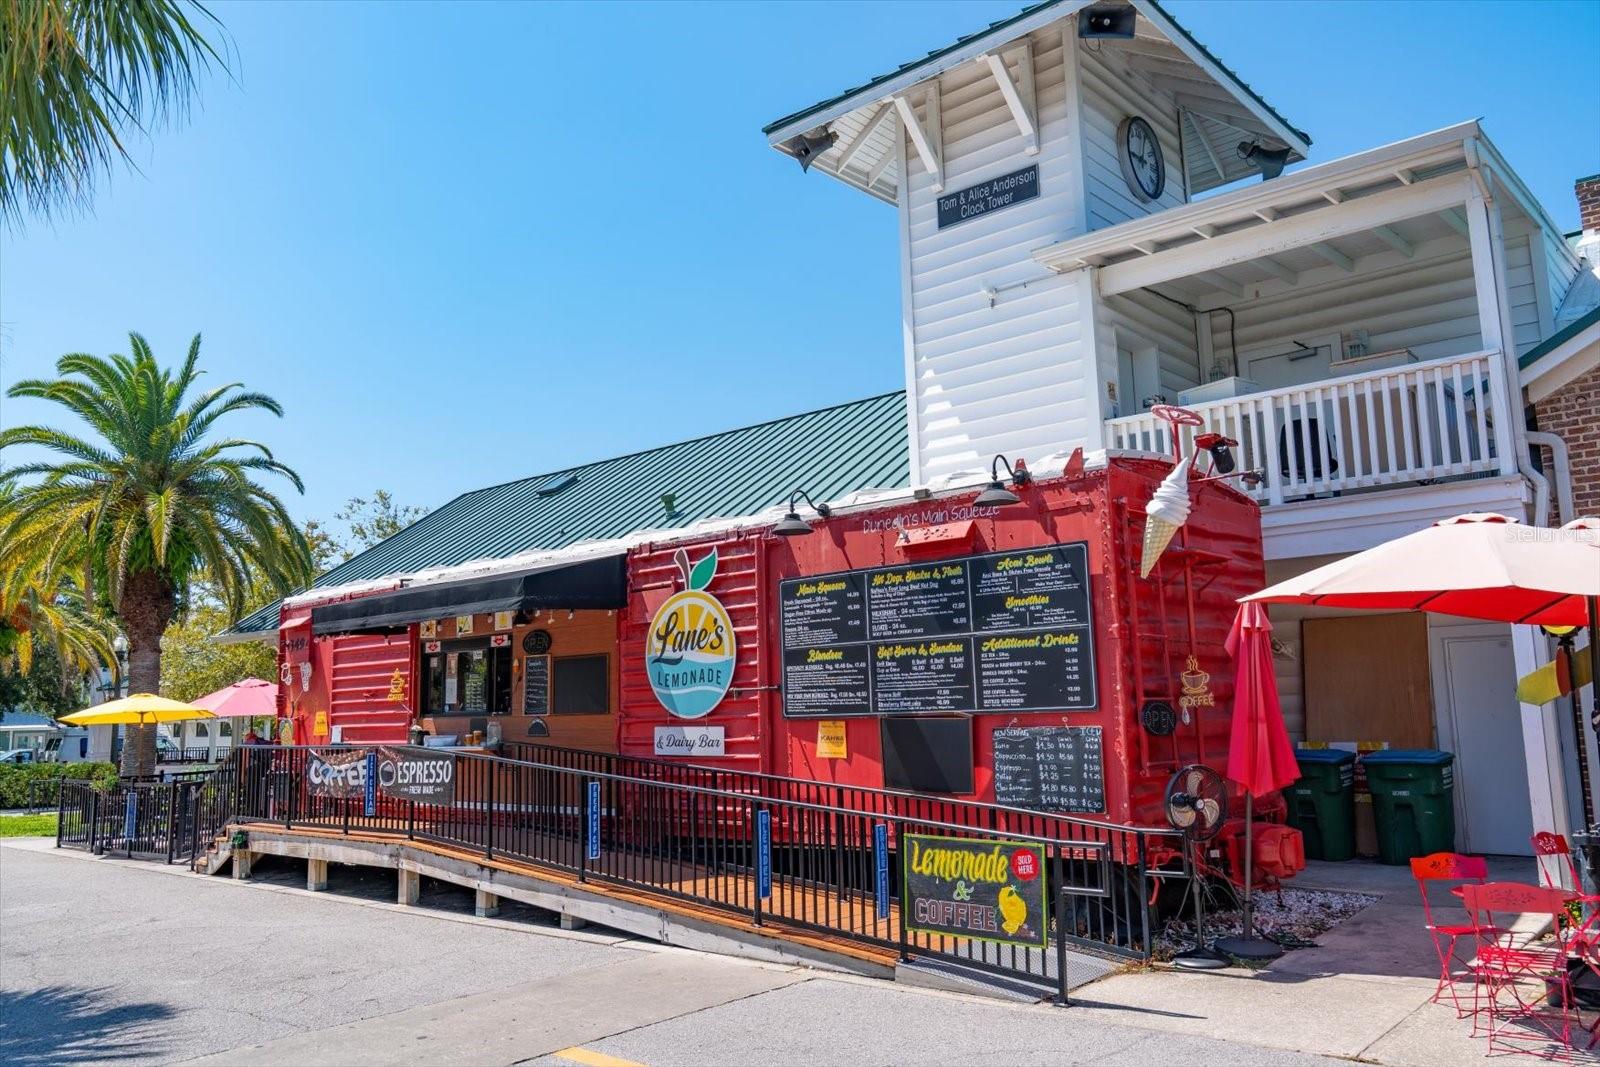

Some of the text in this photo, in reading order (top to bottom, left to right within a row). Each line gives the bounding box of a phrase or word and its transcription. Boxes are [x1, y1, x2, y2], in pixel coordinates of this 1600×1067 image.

[940, 170, 1035, 210] Tom & Alice Anderson
[961, 192, 1013, 217] Clock Tower
[864, 506, 1000, 533] Dunedin's Main Squeeze
[1025, 554, 1053, 567] Bowls
[906, 570, 930, 582] Shakes
[933, 568, 941, 578] &
[942, 566, 962, 577] Floats
[796, 584, 816, 596] Main
[1006, 595, 1049, 608] Smoothies
[652, 612, 723, 665] Lane's
[982, 633, 1079, 651] Additional Drinks
[877, 643, 963, 660] Soft Serve & Sundaes
[658, 668, 722, 687] LEMONADE
[657, 735, 720, 749] & Dairy Bar
[398, 760, 451, 783] ESPRESSO
[423, 786, 434, 794] MADE
[912, 841, 1008, 883] Lemonade
[1018, 855, 1032, 864] SOLD
[1018, 864, 1034, 874] HERE
[953, 880, 974, 900] &
[915, 898, 997, 931] COFFEE
